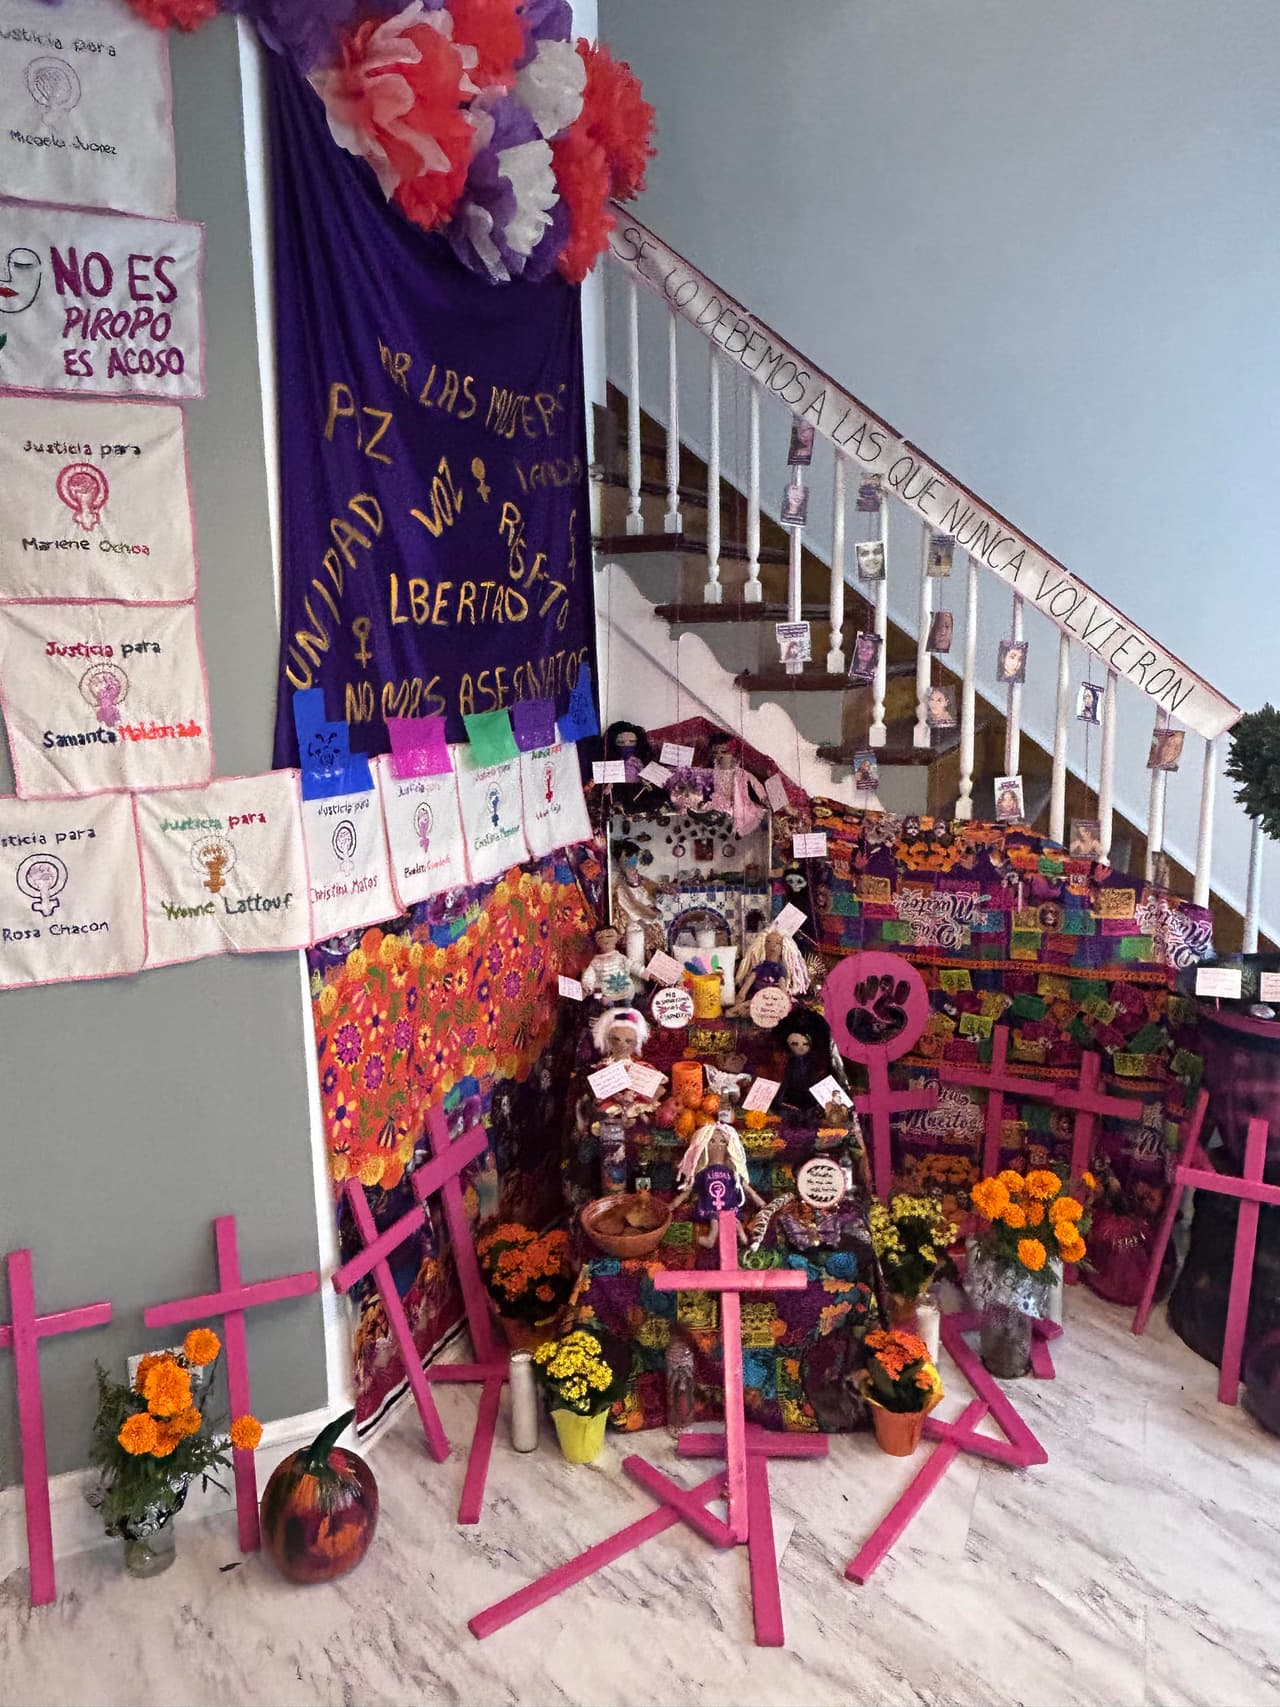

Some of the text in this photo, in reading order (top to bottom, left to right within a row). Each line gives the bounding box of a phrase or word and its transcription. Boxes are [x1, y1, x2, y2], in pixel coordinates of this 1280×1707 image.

[0, 28, 63, 50] usticia
[50, 246, 178, 303] NO ES
[62, 306, 172, 342] PIROPO
[64, 347, 185, 378] ES ACOSO
[419, 364, 477, 419] LAS
[24, 440, 141, 458] Justicia para
[612, 227, 1195, 712] SE LO DEBEMOS A LAS QUE NUNCA VOLVIERON
[286, 492, 383, 690] UNIDAD
[46, 640, 161, 658] Justicia para
[345, 680, 375, 724] NO
[381, 675, 446, 719] MAS
[43, 727, 117, 749] Samanta
[228, 813, 267, 829] para
[0, 829, 96, 848] sticia para
[224, 893, 293, 914] Lattouf
[2, 921, 110, 942] Rosa Chacon
